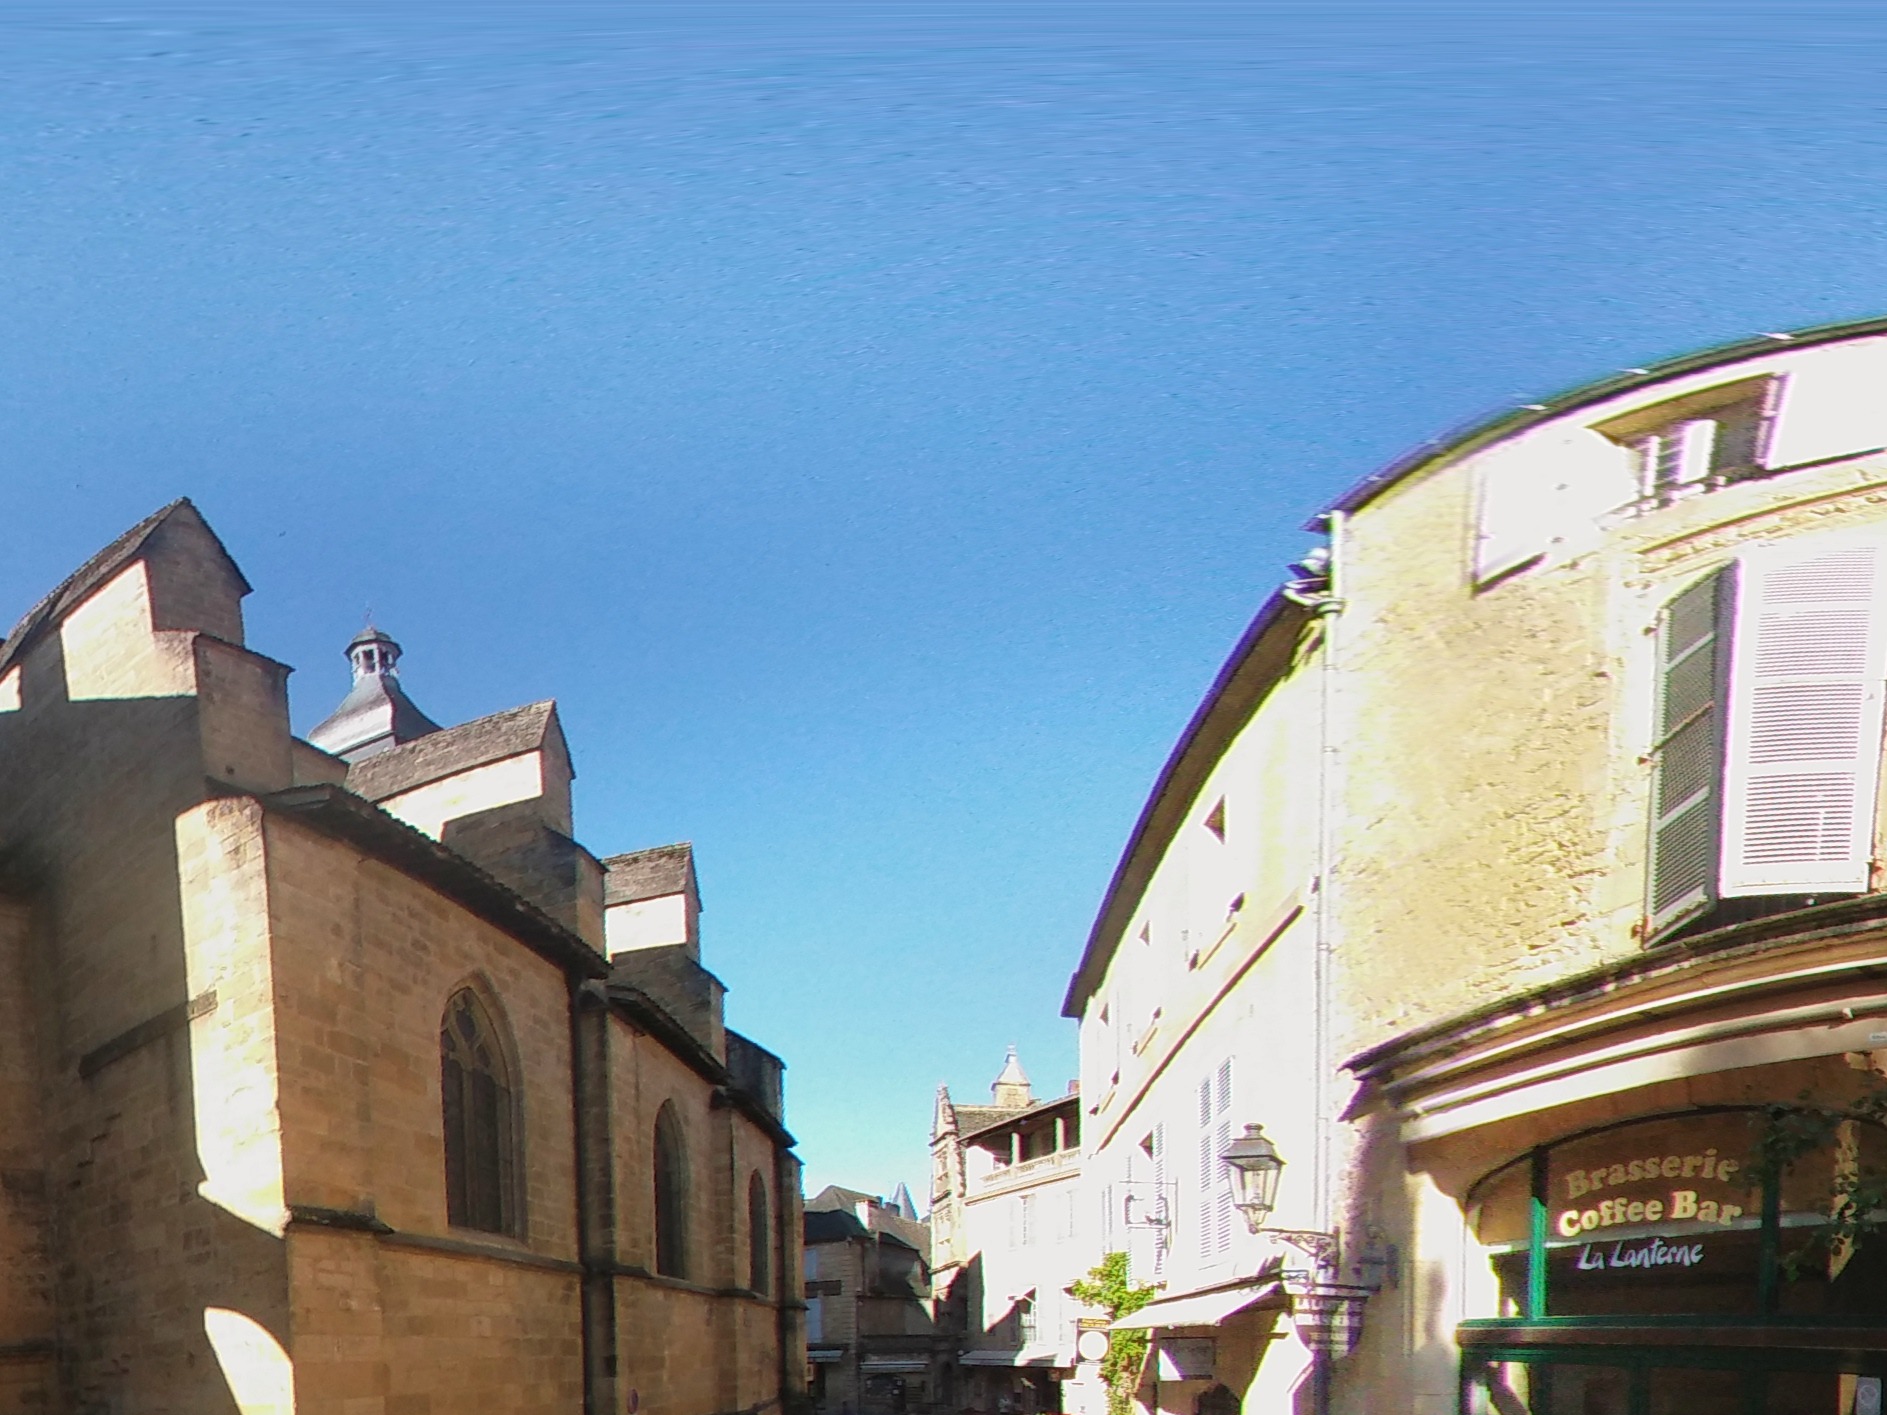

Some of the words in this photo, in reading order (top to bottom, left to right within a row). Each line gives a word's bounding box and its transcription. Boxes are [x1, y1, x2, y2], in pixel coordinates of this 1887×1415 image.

[1565, 1148, 1740, 1200] Brasserie
[1558, 1197, 1665, 1238] Coffee
[1669, 1190, 1743, 1226] Bar
[1577, 1243, 1606, 1271] La
[1610, 1237, 1705, 1269] Lanterne
